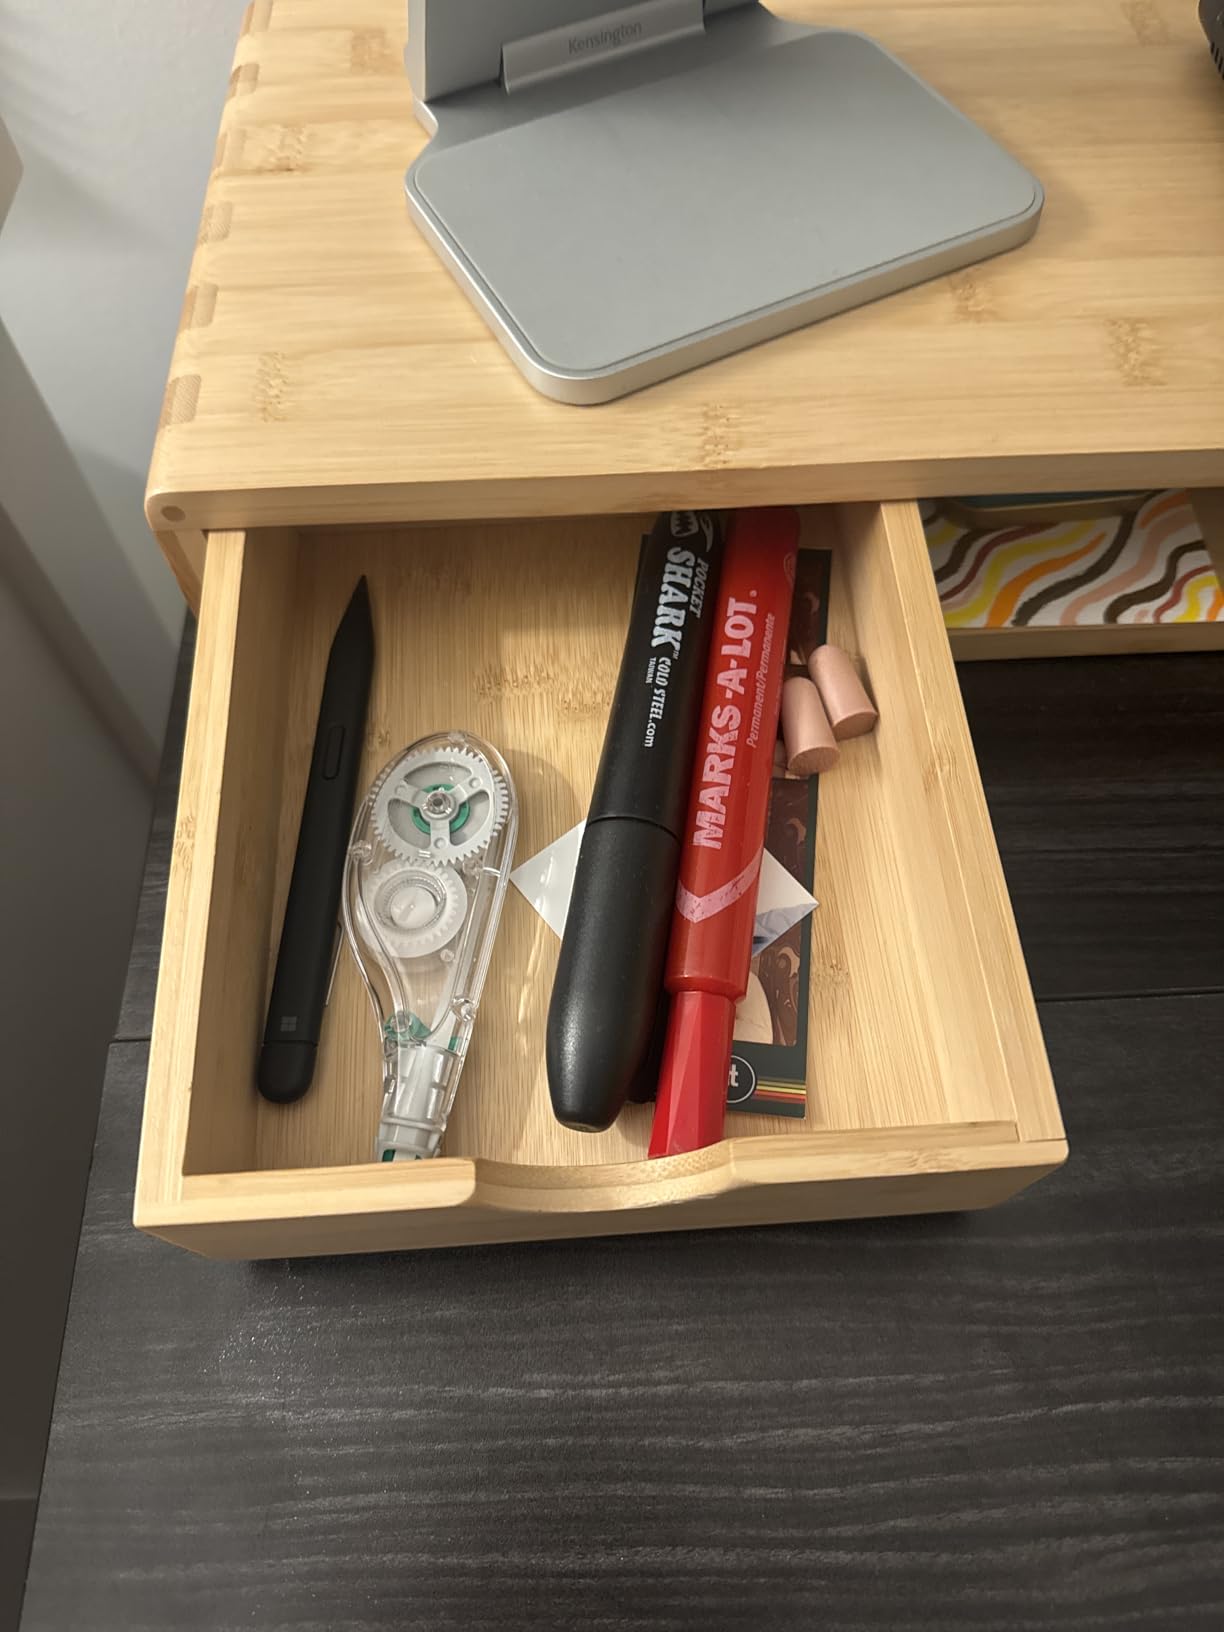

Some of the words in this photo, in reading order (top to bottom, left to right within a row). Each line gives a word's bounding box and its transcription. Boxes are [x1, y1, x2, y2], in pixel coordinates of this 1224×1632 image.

[568, 21, 643, 55] Kensington
[650, 546, 696, 650] SHARK
[688, 556, 709, 619] POCKET
[645, 656, 657, 684] TAIWAN
[654, 656, 672, 687] COLD
[643, 688, 666, 748] STEEL.com
